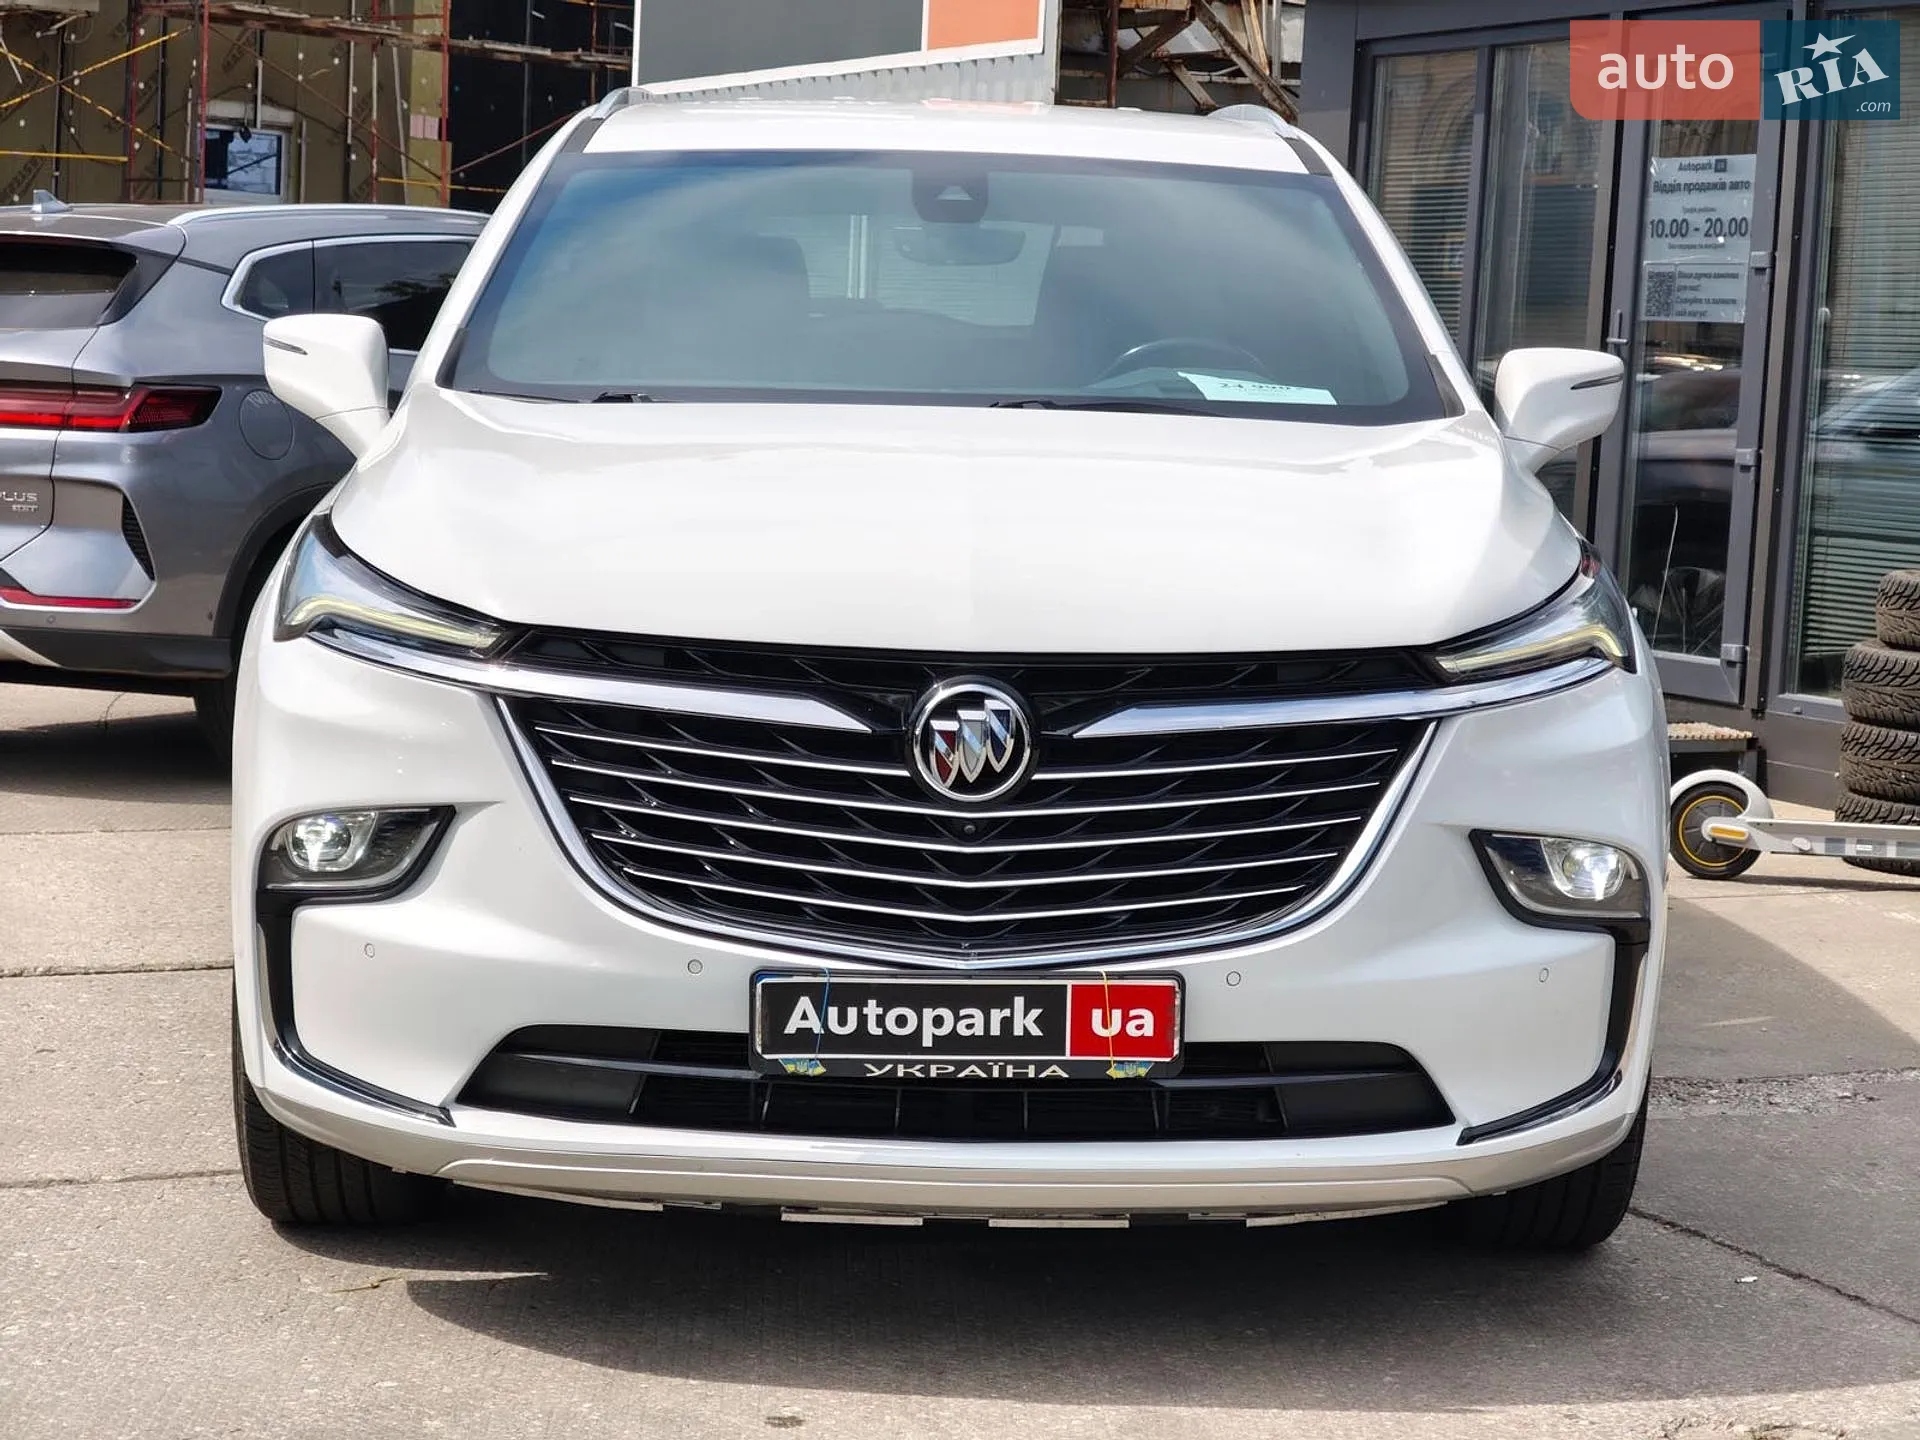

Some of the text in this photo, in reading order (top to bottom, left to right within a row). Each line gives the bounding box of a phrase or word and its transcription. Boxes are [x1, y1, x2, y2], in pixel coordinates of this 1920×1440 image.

[1678, 161, 1712, 173] Autopark
[1728, 180, 1751, 190] авто
[1650, 218, 1690, 239] 10.00
[1704, 217, 1749, 237] 20.00
[783, 996, 1155, 1047] Autopark ua
[863, 1062, 1070, 1079] УКРАЇНА
